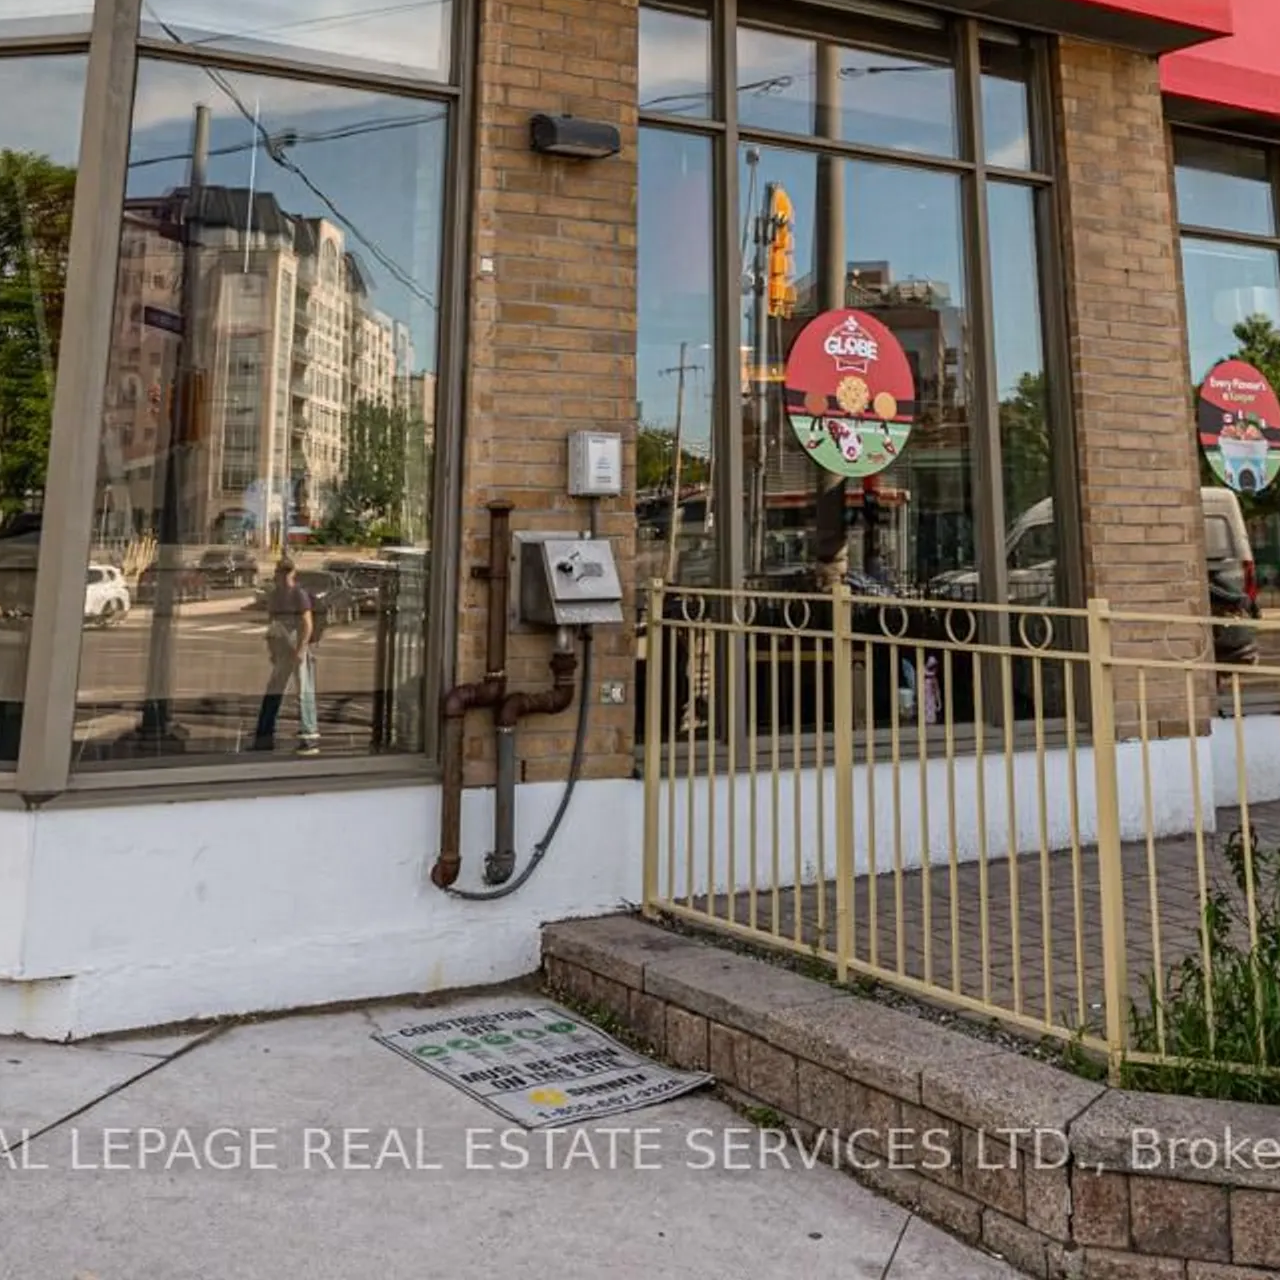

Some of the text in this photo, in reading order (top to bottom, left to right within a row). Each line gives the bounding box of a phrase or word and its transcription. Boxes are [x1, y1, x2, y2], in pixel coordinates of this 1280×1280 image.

[824, 336, 879, 361] GLOBE
[398, 1009, 537, 1037] CONSTRUCTION
[460, 1047, 620, 1083] MUST BE WORN
[490, 1076, 527, 1090] ON
[576, 1057, 623, 1073] SITE
